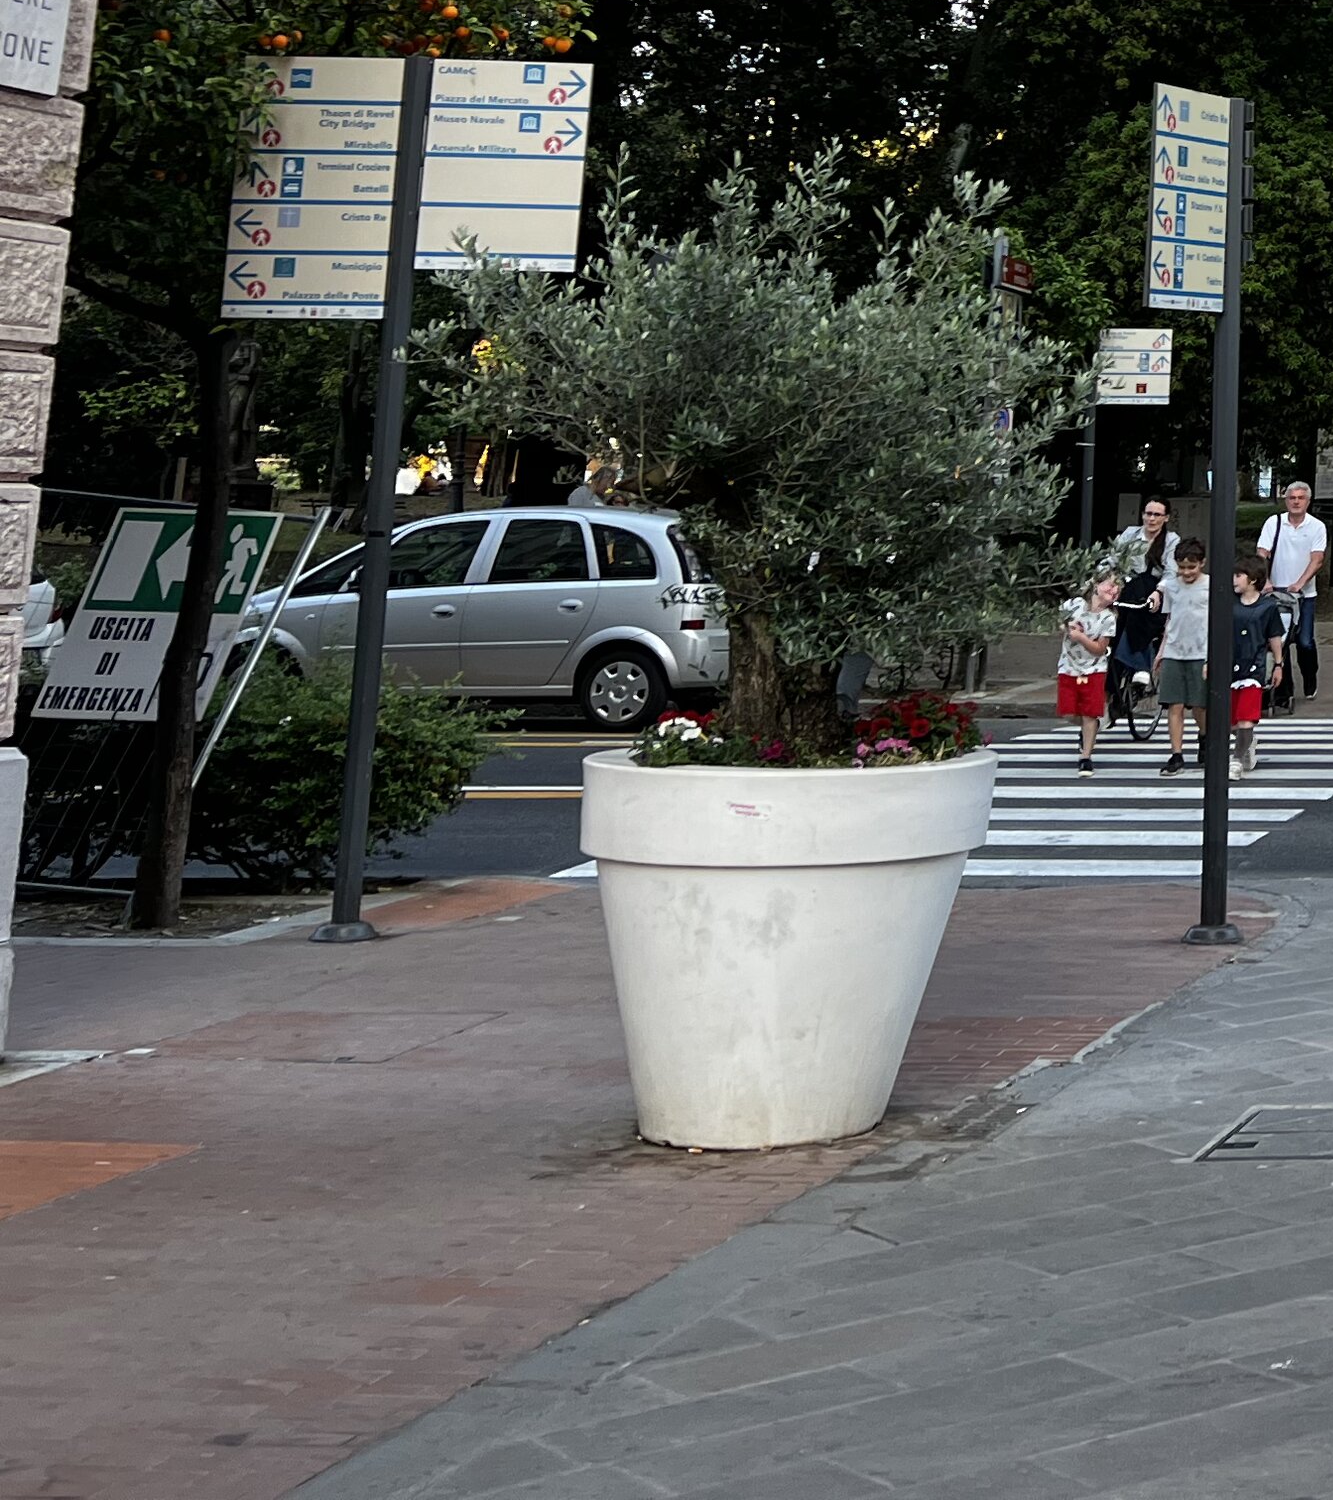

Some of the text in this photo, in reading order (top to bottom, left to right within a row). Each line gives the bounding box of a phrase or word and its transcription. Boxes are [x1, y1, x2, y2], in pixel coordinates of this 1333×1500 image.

[0, 30, 53, 66] ONE
[438, 66, 477, 75] CAMeC
[435, 94, 529, 104] Piazza del Mercato
[320, 109, 395, 118] Thaon di Revel
[433, 115, 505, 124] Museo Navale
[319, 119, 376, 131] City Bridge
[344, 141, 393, 149] Mirabello
[431, 144, 517, 153] Arsenale Militare
[317, 162, 391, 172] Terminal Crociere
[353, 185, 389, 193] Battelli
[341, 213, 387, 222] Cristo Re
[331, 263, 383, 273] Municipio
[323, 292, 350, 300] delle
[352, 292, 380, 300] Poste
[88, 616, 155, 642] USCITA
[94, 652, 121, 676] DI
[38, 686, 145, 712] EMERGENZA
